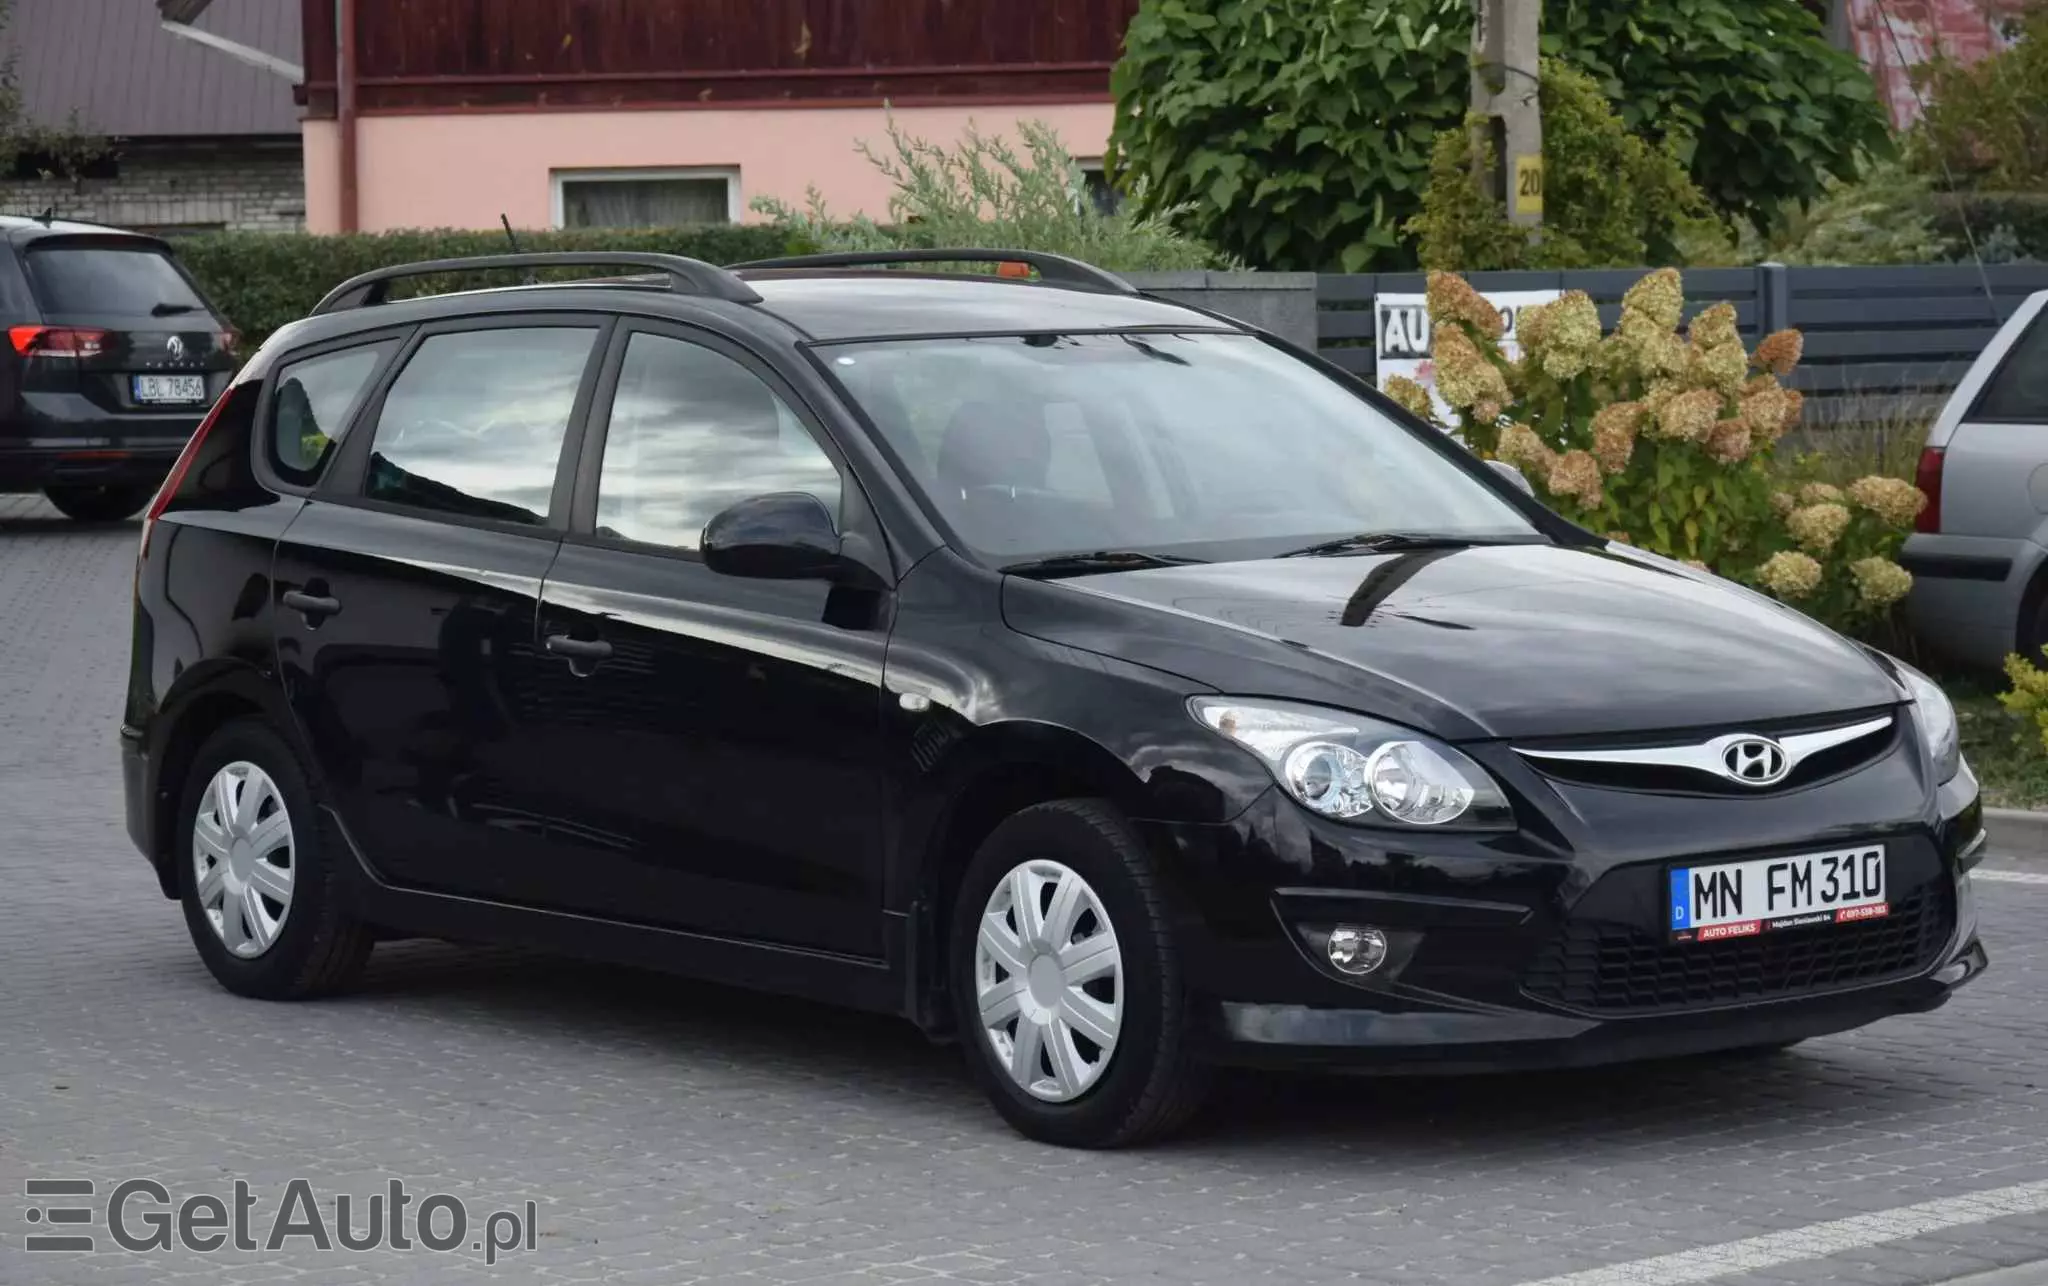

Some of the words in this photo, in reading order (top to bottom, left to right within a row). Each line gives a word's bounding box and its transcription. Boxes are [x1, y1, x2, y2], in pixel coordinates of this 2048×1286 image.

[1519, 168, 1540, 197] 20
[141, 377, 164, 397] LBL
[167, 376, 202, 397] 78456
[1694, 869, 1743, 920] MN
[1767, 860, 1812, 911] FM
[1820, 851, 1881, 903] 310
[1675, 905, 1684, 920] D
[1703, 927, 1727, 938] AUTO
[1727, 923, 1756, 935] FELIKS
